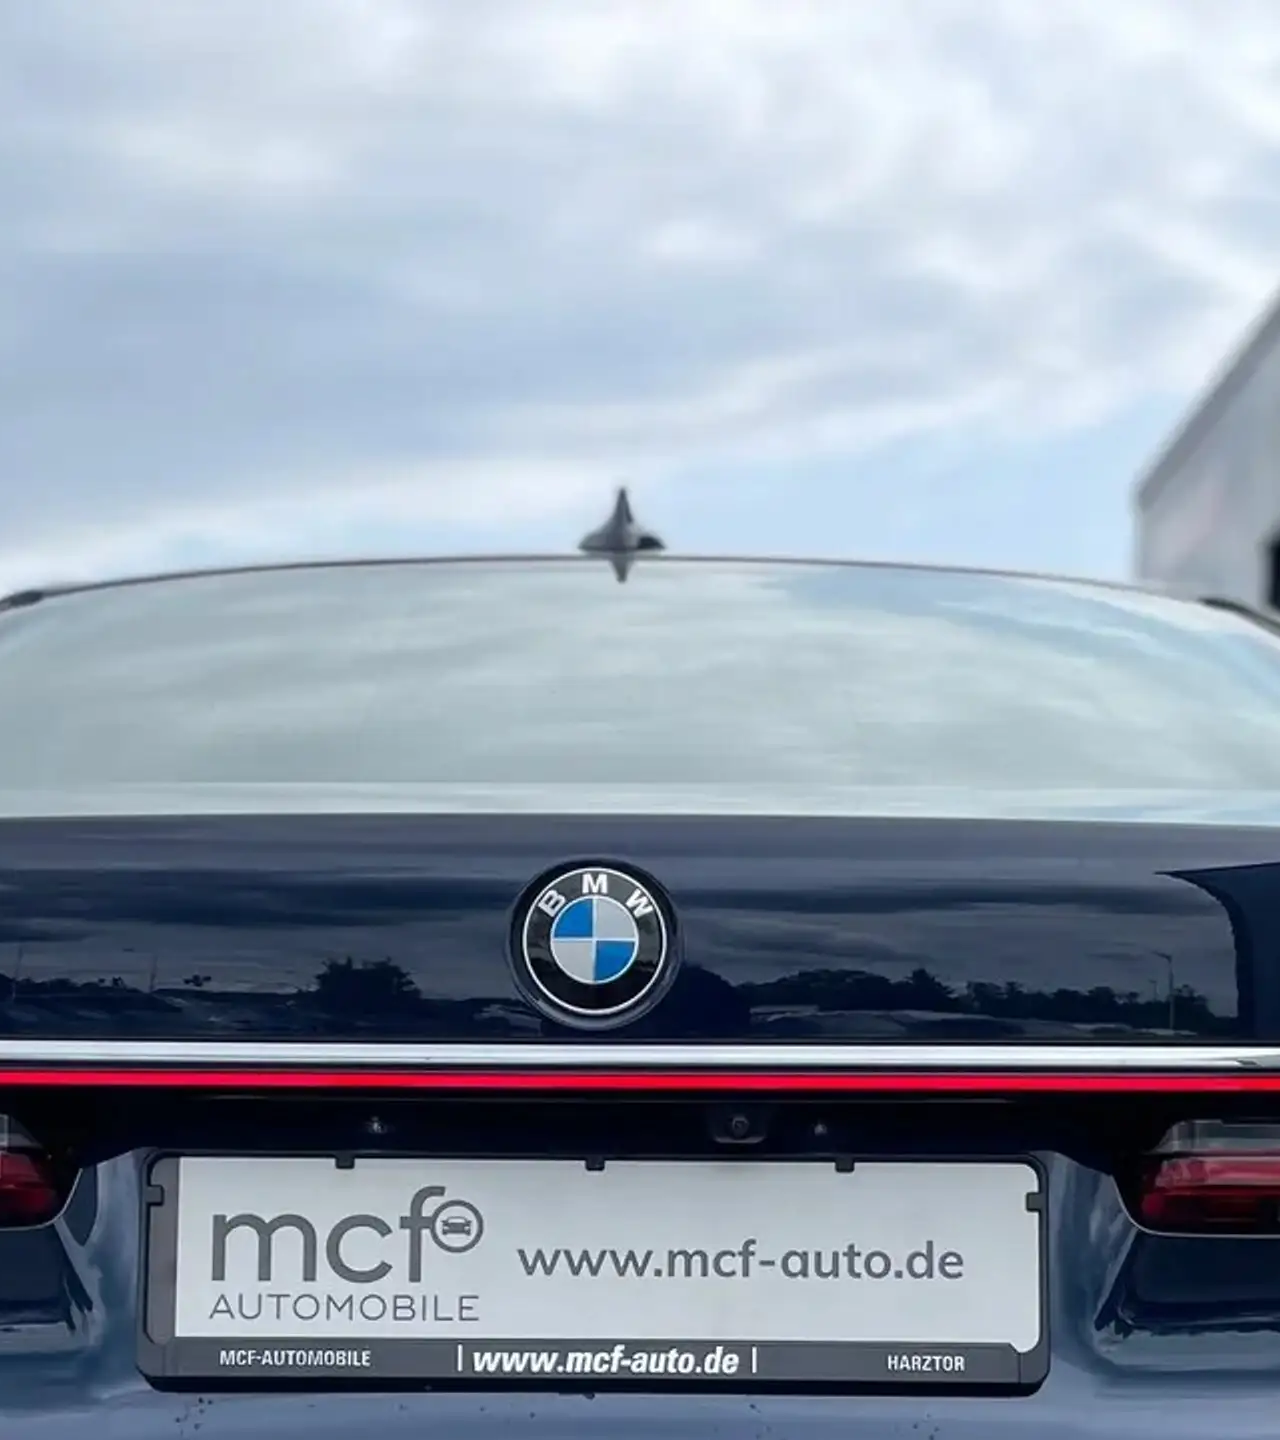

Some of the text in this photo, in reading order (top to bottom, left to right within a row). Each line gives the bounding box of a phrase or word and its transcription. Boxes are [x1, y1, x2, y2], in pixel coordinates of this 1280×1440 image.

[537, 873, 654, 918] BMW
[211, 1185, 447, 1284] mcf
[517, 1238, 964, 1280] www.mcf-auto.de
[209, 1293, 480, 1322] AUTOMOBILE
[219, 1349, 372, 1367] MCF-AUTOMOBILE
[472, 1344, 740, 1375] www.mcf-auto.de
[887, 1354, 966, 1372] HARZTOR
